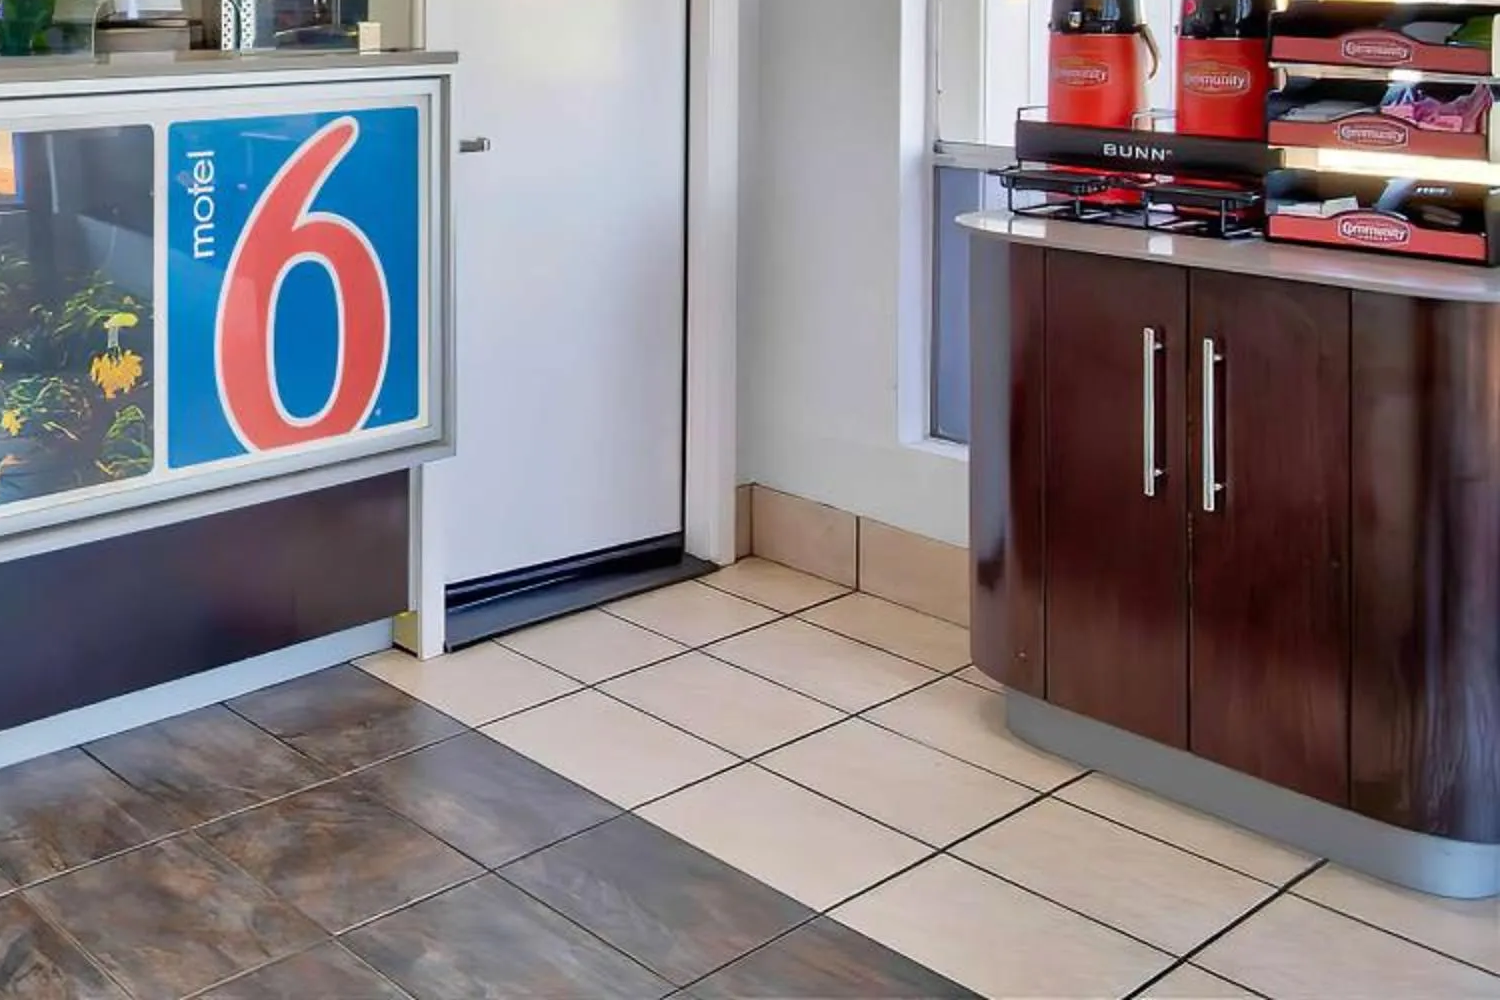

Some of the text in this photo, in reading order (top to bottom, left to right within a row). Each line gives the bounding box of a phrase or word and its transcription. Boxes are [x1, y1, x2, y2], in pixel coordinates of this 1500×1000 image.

[1184, 72, 1245, 89] munity
[1103, 143, 1166, 161] BUNN
[186, 150, 215, 260] motel
[214, 115, 391, 453] 6
